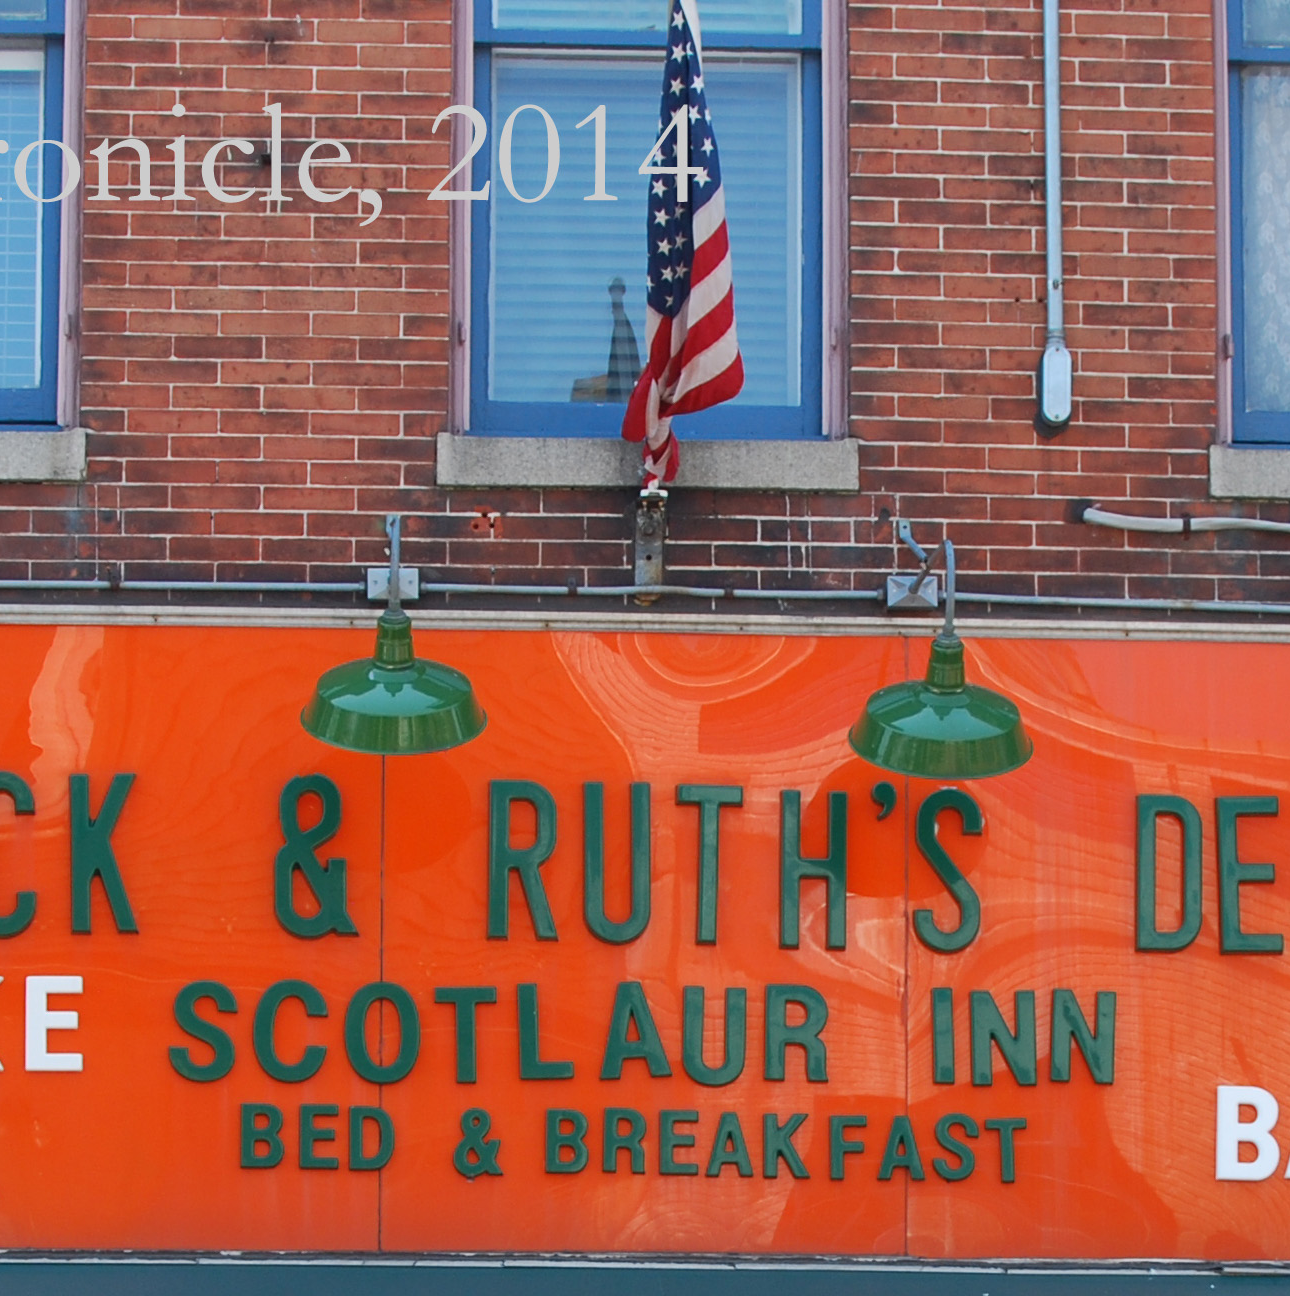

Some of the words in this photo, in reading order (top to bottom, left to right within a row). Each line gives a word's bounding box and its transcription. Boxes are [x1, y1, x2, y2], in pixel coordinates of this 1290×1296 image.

[273, 774, 359, 939] &
[487, 780, 983, 953] RUTH'S
[168, 979, 828, 1086] SCOTLAUR
[931, 987, 1116, 1087] INN
[240, 1103, 395, 1171] BED
[454, 1108, 502, 1177] &
[545, 1108, 1027, 1183] BREAKFAST
